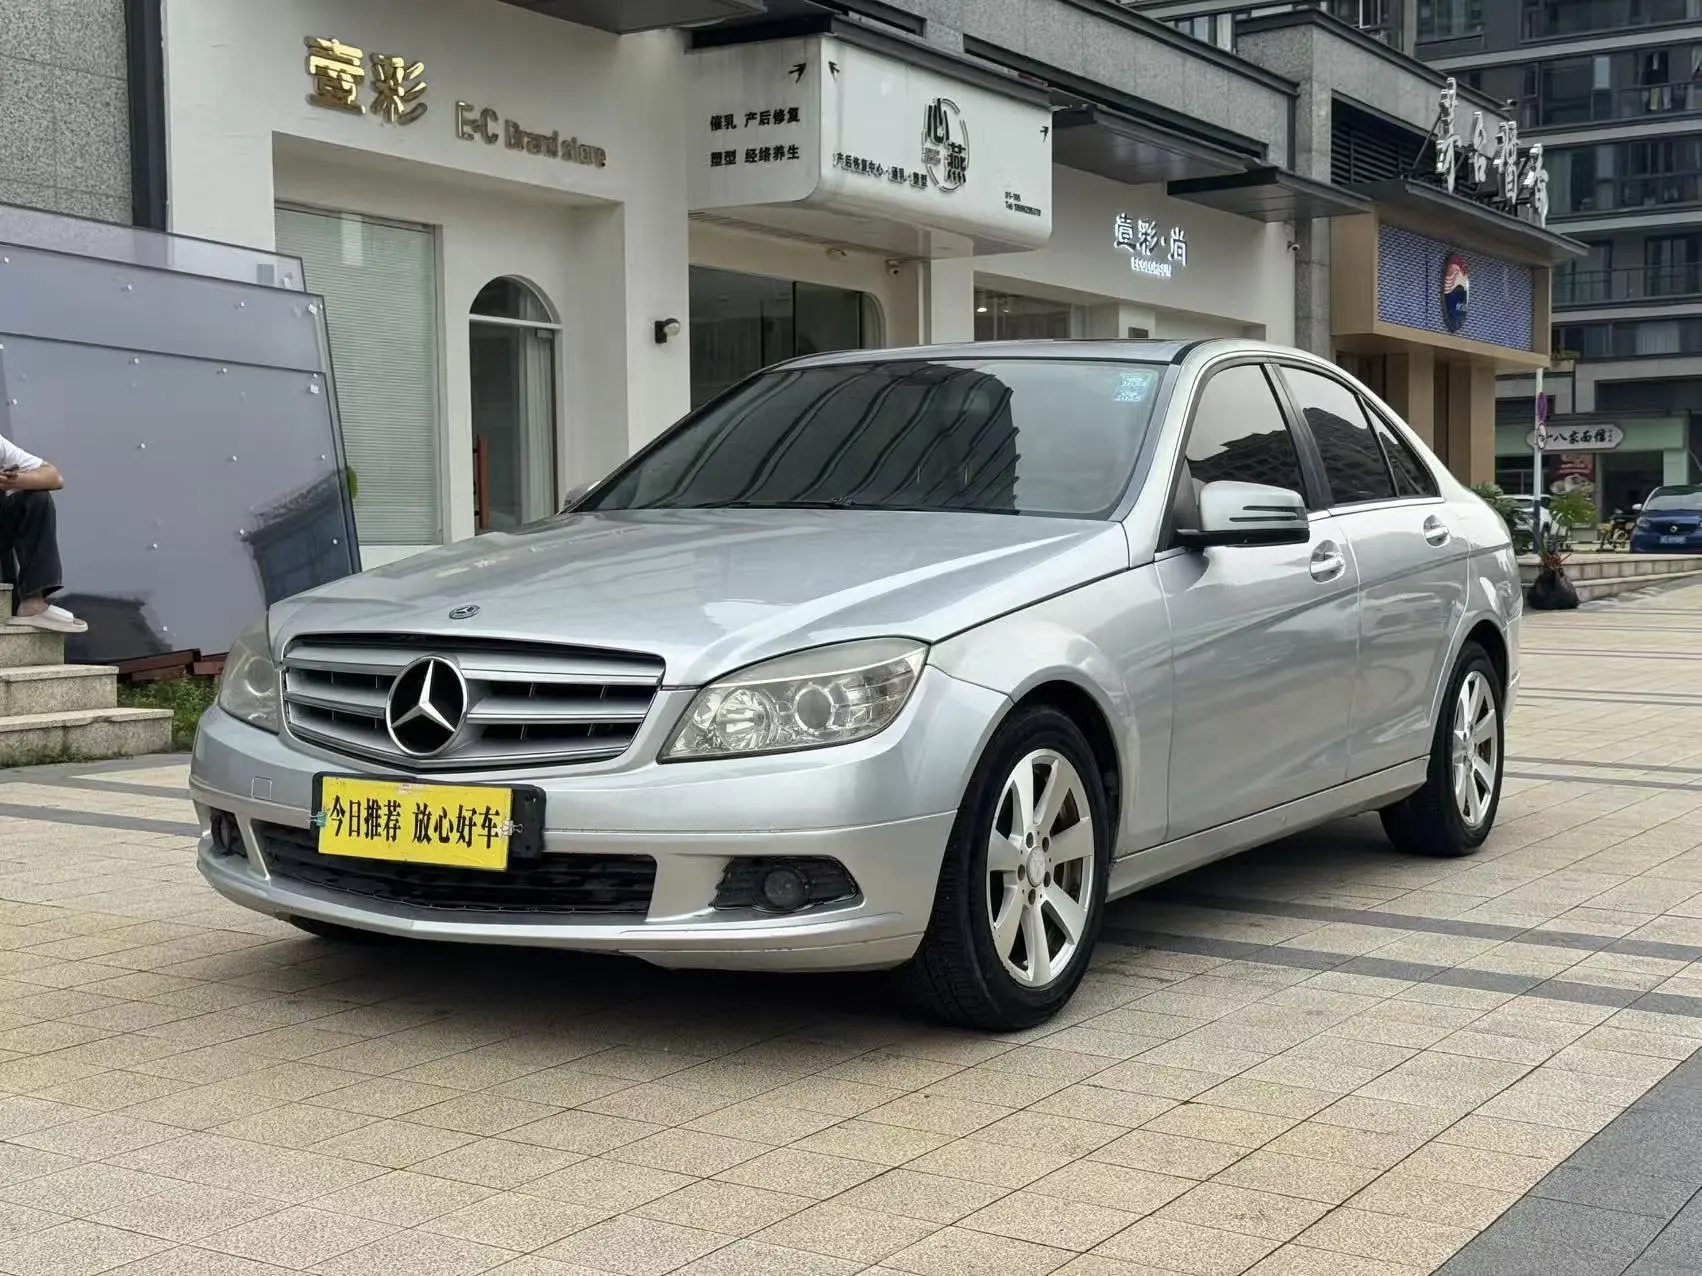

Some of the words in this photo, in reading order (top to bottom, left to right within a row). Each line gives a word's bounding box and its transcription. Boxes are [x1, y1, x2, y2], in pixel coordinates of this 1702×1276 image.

[303, 35, 428, 125] 壹彩
[504, 118, 559, 159] Brand
[710, 113, 737, 131] 催乳
[744, 107, 800, 128] 产后修复
[710, 149, 737, 167] 塑型
[744, 144, 800, 163] 经络养生
[329, 794, 402, 842] 今日推荐
[411, 801, 501, 850] 放心好车
